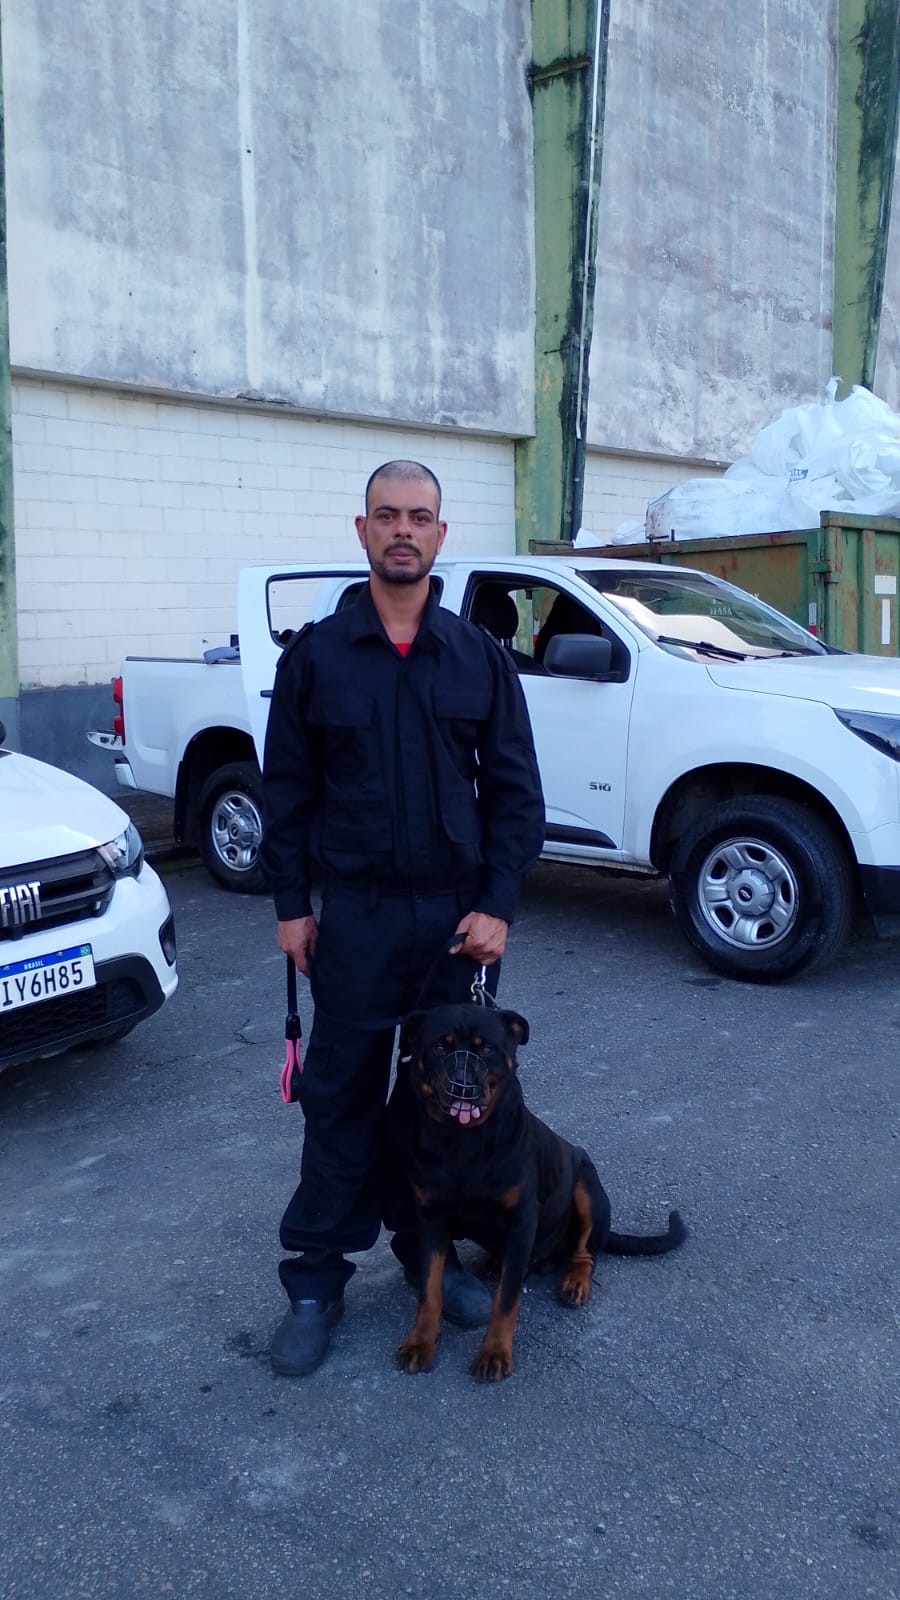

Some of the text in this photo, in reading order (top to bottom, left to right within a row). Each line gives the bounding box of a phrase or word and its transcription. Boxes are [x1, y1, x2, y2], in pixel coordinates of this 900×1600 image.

[589, 781, 611, 791] S10
[0, 881, 42, 927] FIAT
[23, 959, 45, 970] BRASIL
